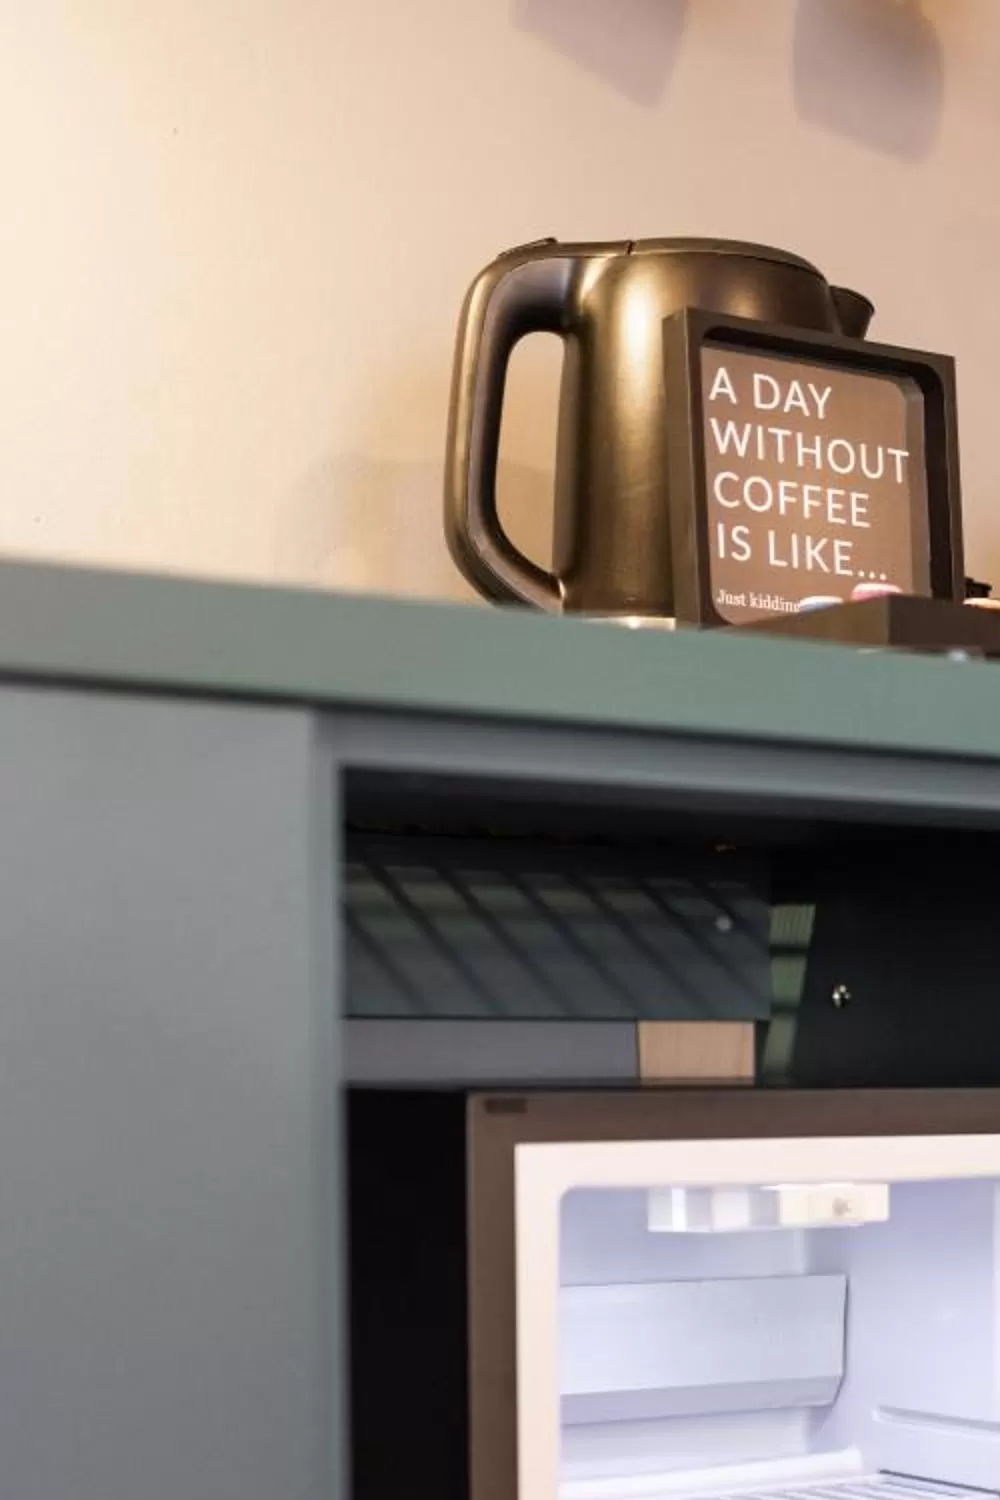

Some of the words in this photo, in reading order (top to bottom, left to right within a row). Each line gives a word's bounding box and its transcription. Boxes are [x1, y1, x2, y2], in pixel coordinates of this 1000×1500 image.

[709, 367, 737, 404] A
[753, 373, 832, 419] DAY
[709, 417, 910, 483] WITHOUT
[714, 471, 871, 528] COFFEE
[717, 523, 751, 561] IS
[768, 530, 887, 581] LIKE...
[716, 588, 747, 607] Just
